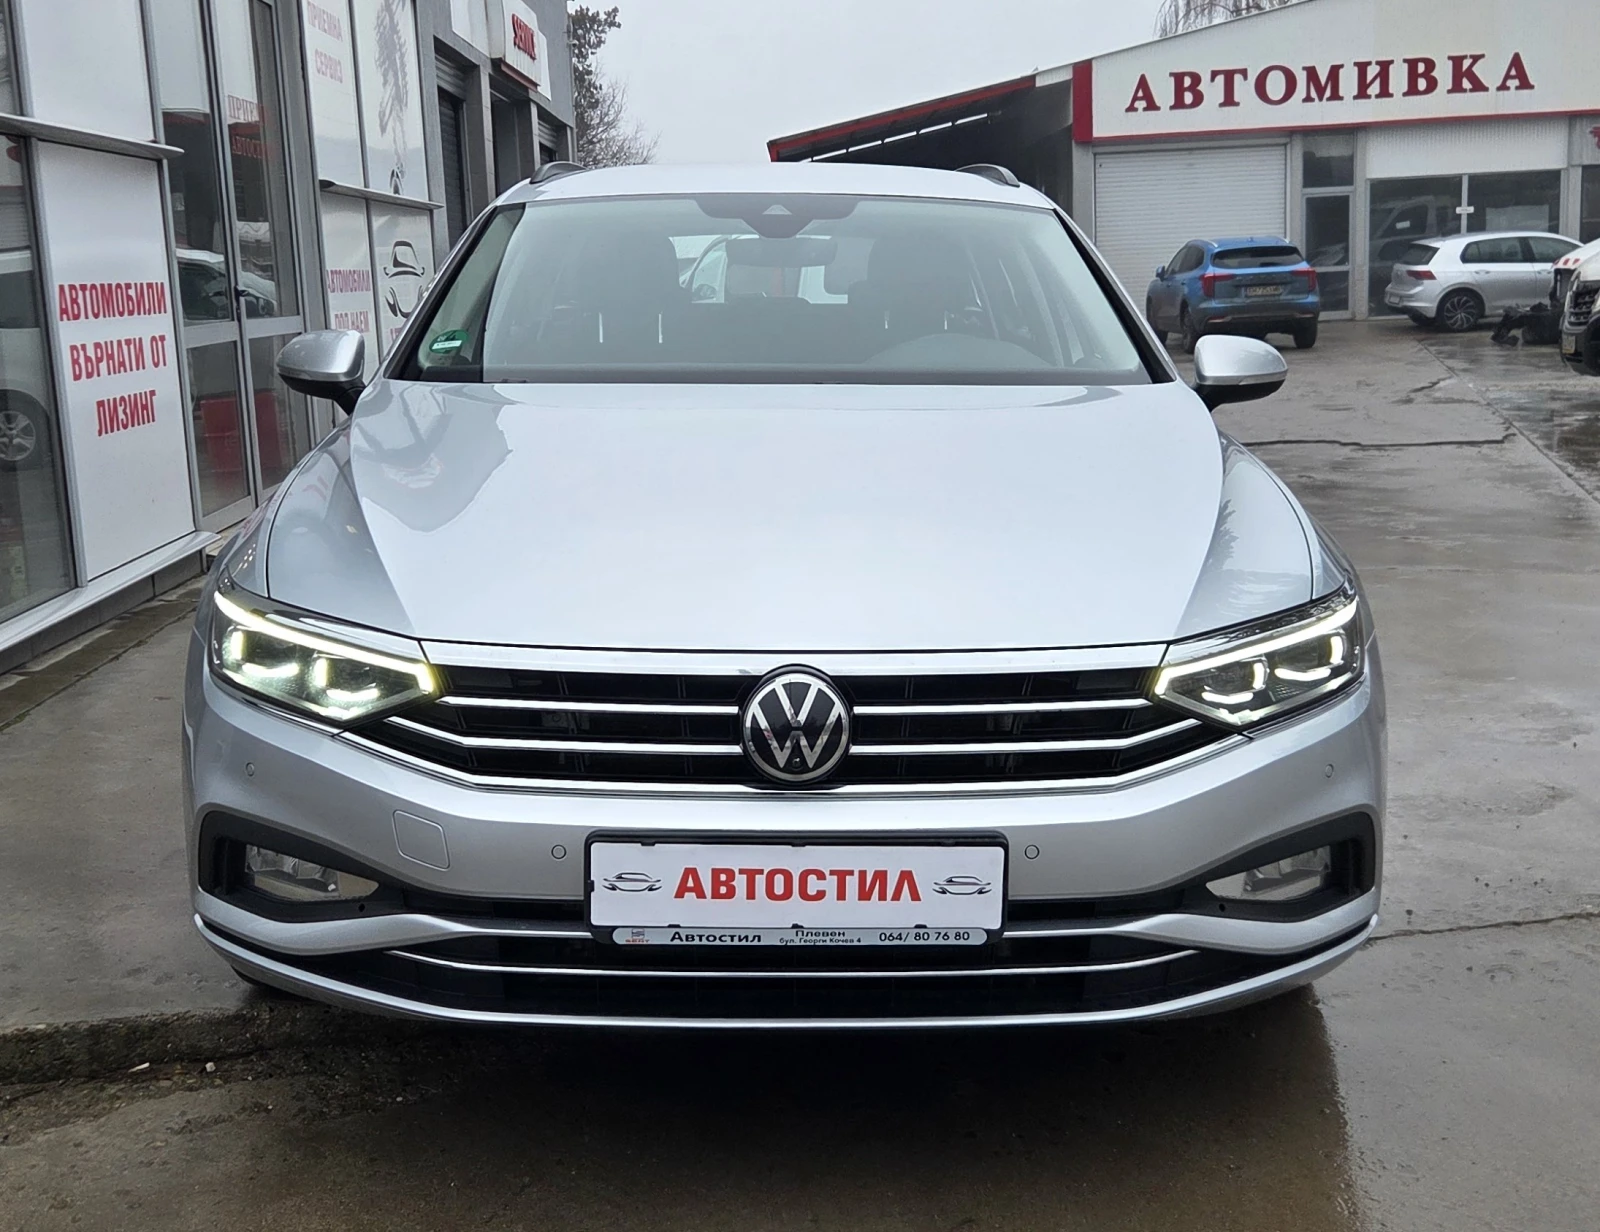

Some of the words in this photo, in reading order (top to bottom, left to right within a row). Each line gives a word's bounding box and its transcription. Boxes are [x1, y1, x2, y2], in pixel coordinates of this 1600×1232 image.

[314, 48, 343, 84] СЕРВИЗ
[1124, 51, 1535, 113] АВТОМИВКА
[58, 281, 167, 322] АВТОМОБИЛИ
[69, 336, 146, 382] ВЪРНАТИ
[150, 334, 167, 368] ОТ
[96, 389, 157, 437] ЛИЗИНГ
[673, 866, 922, 902] АВТОСТИЛ
[669, 931, 762, 943] Автостил
[795, 929, 846, 938] Плевен
[856, 936, 862, 944] 4
[879, 932, 910, 943] 064/
[914, 931, 930, 941] 80
[934, 931, 950, 941] 76
[954, 931, 970, 941] 80
